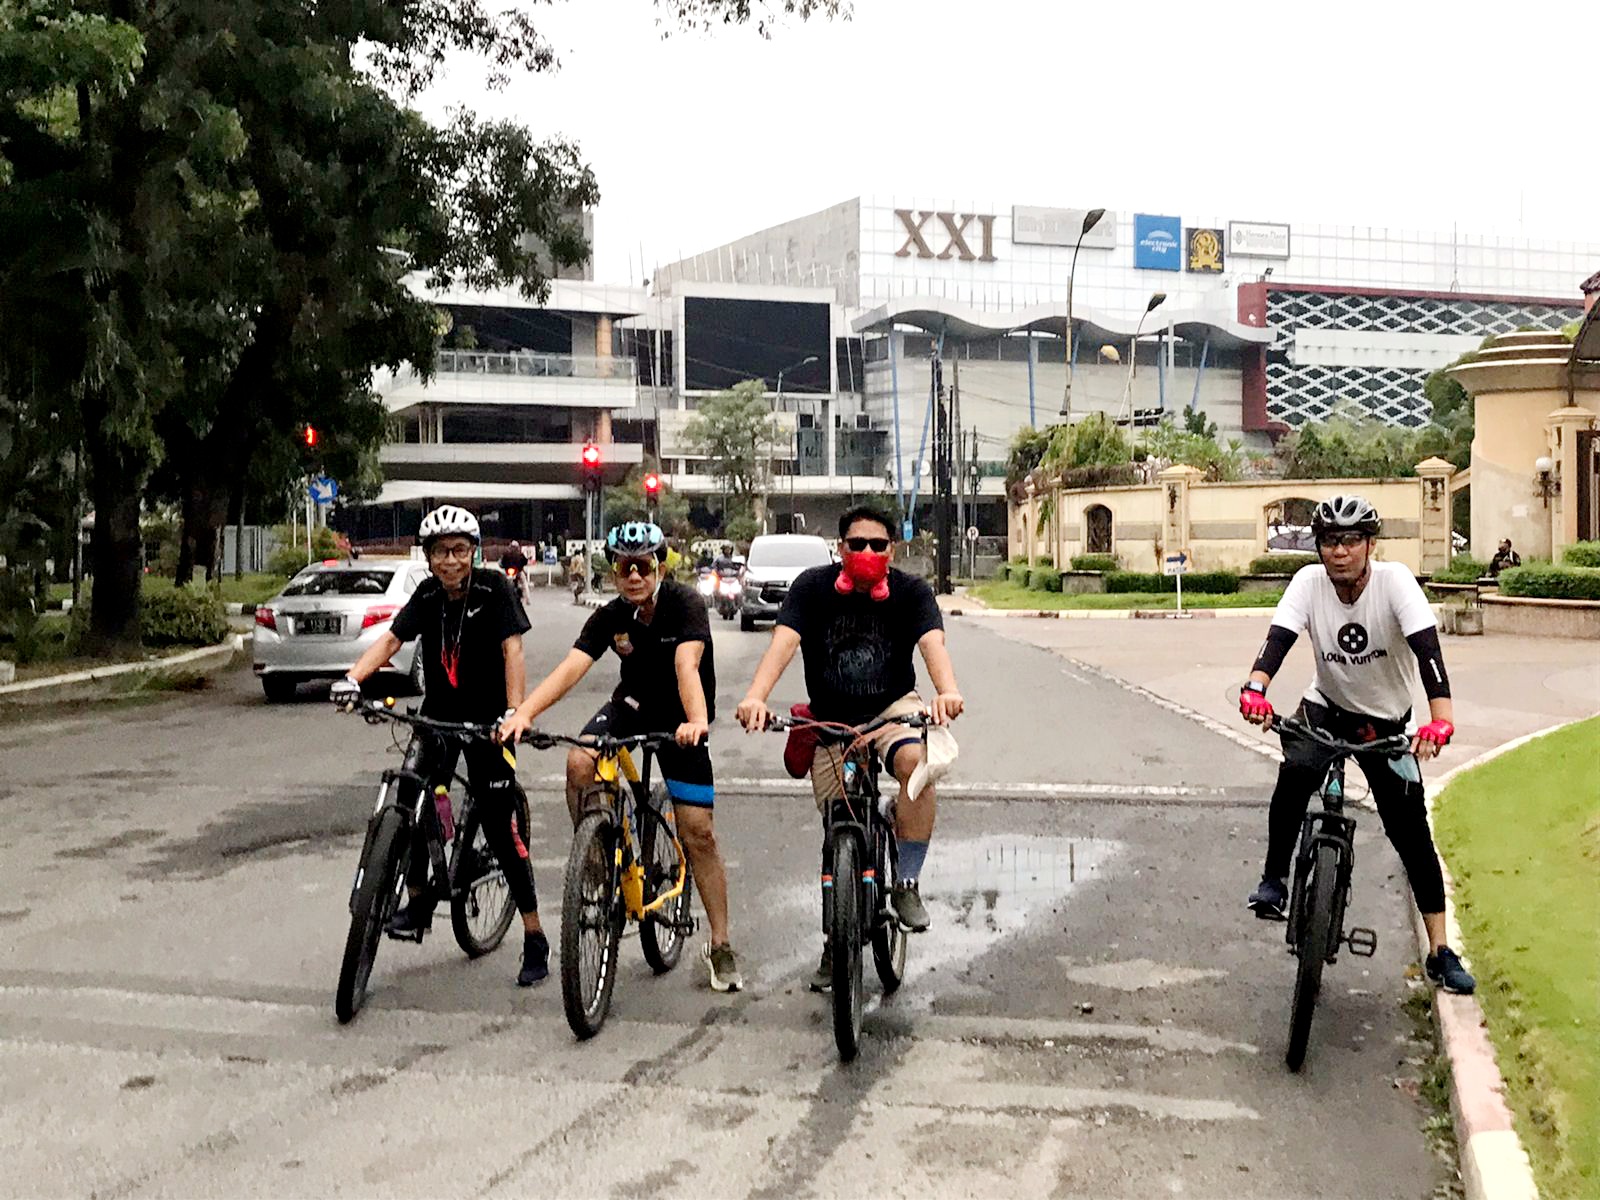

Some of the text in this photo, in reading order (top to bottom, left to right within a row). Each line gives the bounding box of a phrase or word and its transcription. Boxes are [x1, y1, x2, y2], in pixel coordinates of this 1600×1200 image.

[894, 209, 998, 262] XXI
[1321, 649, 1388, 666] LOUIS VUITTON
